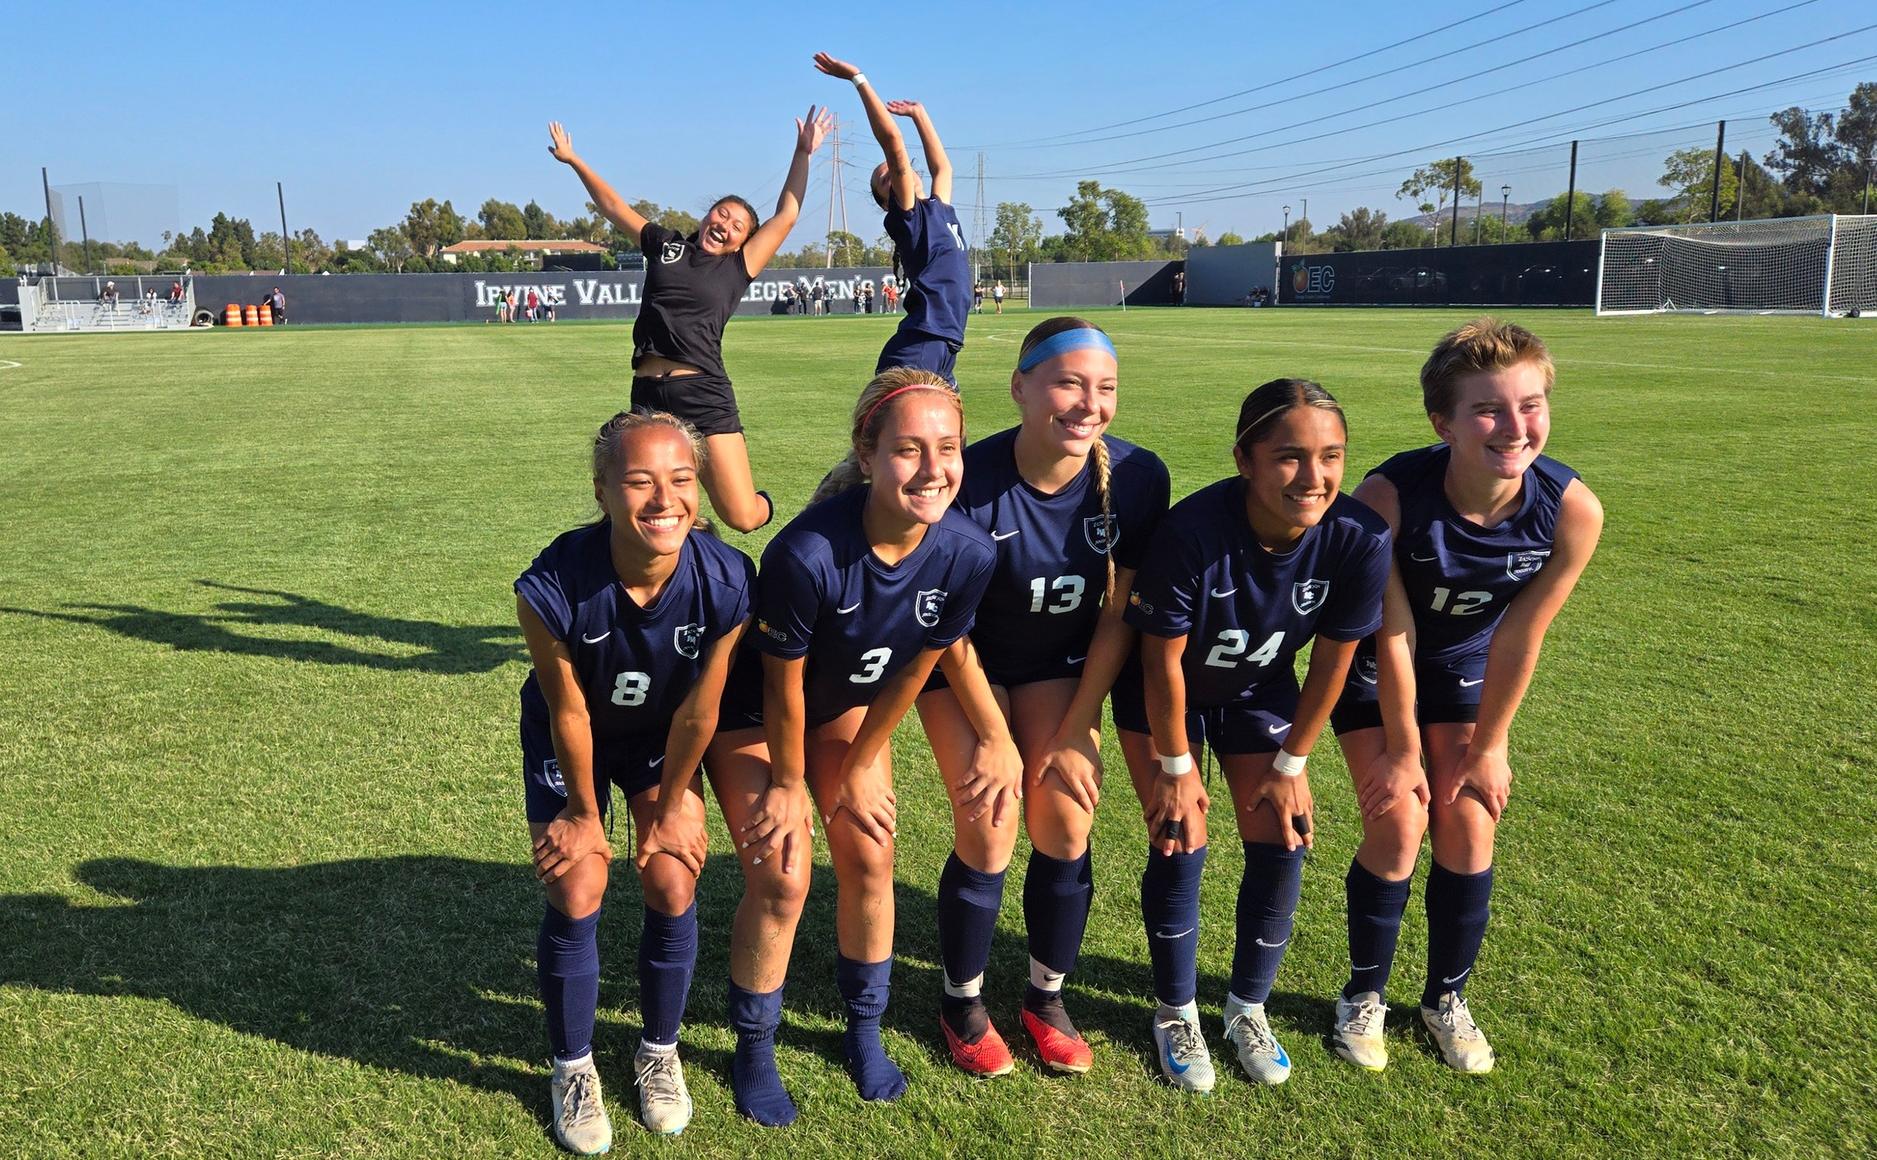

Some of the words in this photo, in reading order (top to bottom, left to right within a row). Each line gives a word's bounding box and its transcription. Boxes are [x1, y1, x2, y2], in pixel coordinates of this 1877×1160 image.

[573, 279, 642, 304] VALL
[1030, 575, 1085, 614] 13
[1430, 586, 1493, 616] 12
[849, 647, 892, 683] 3
[1205, 629, 1286, 668] 24
[610, 671, 651, 706] 8
